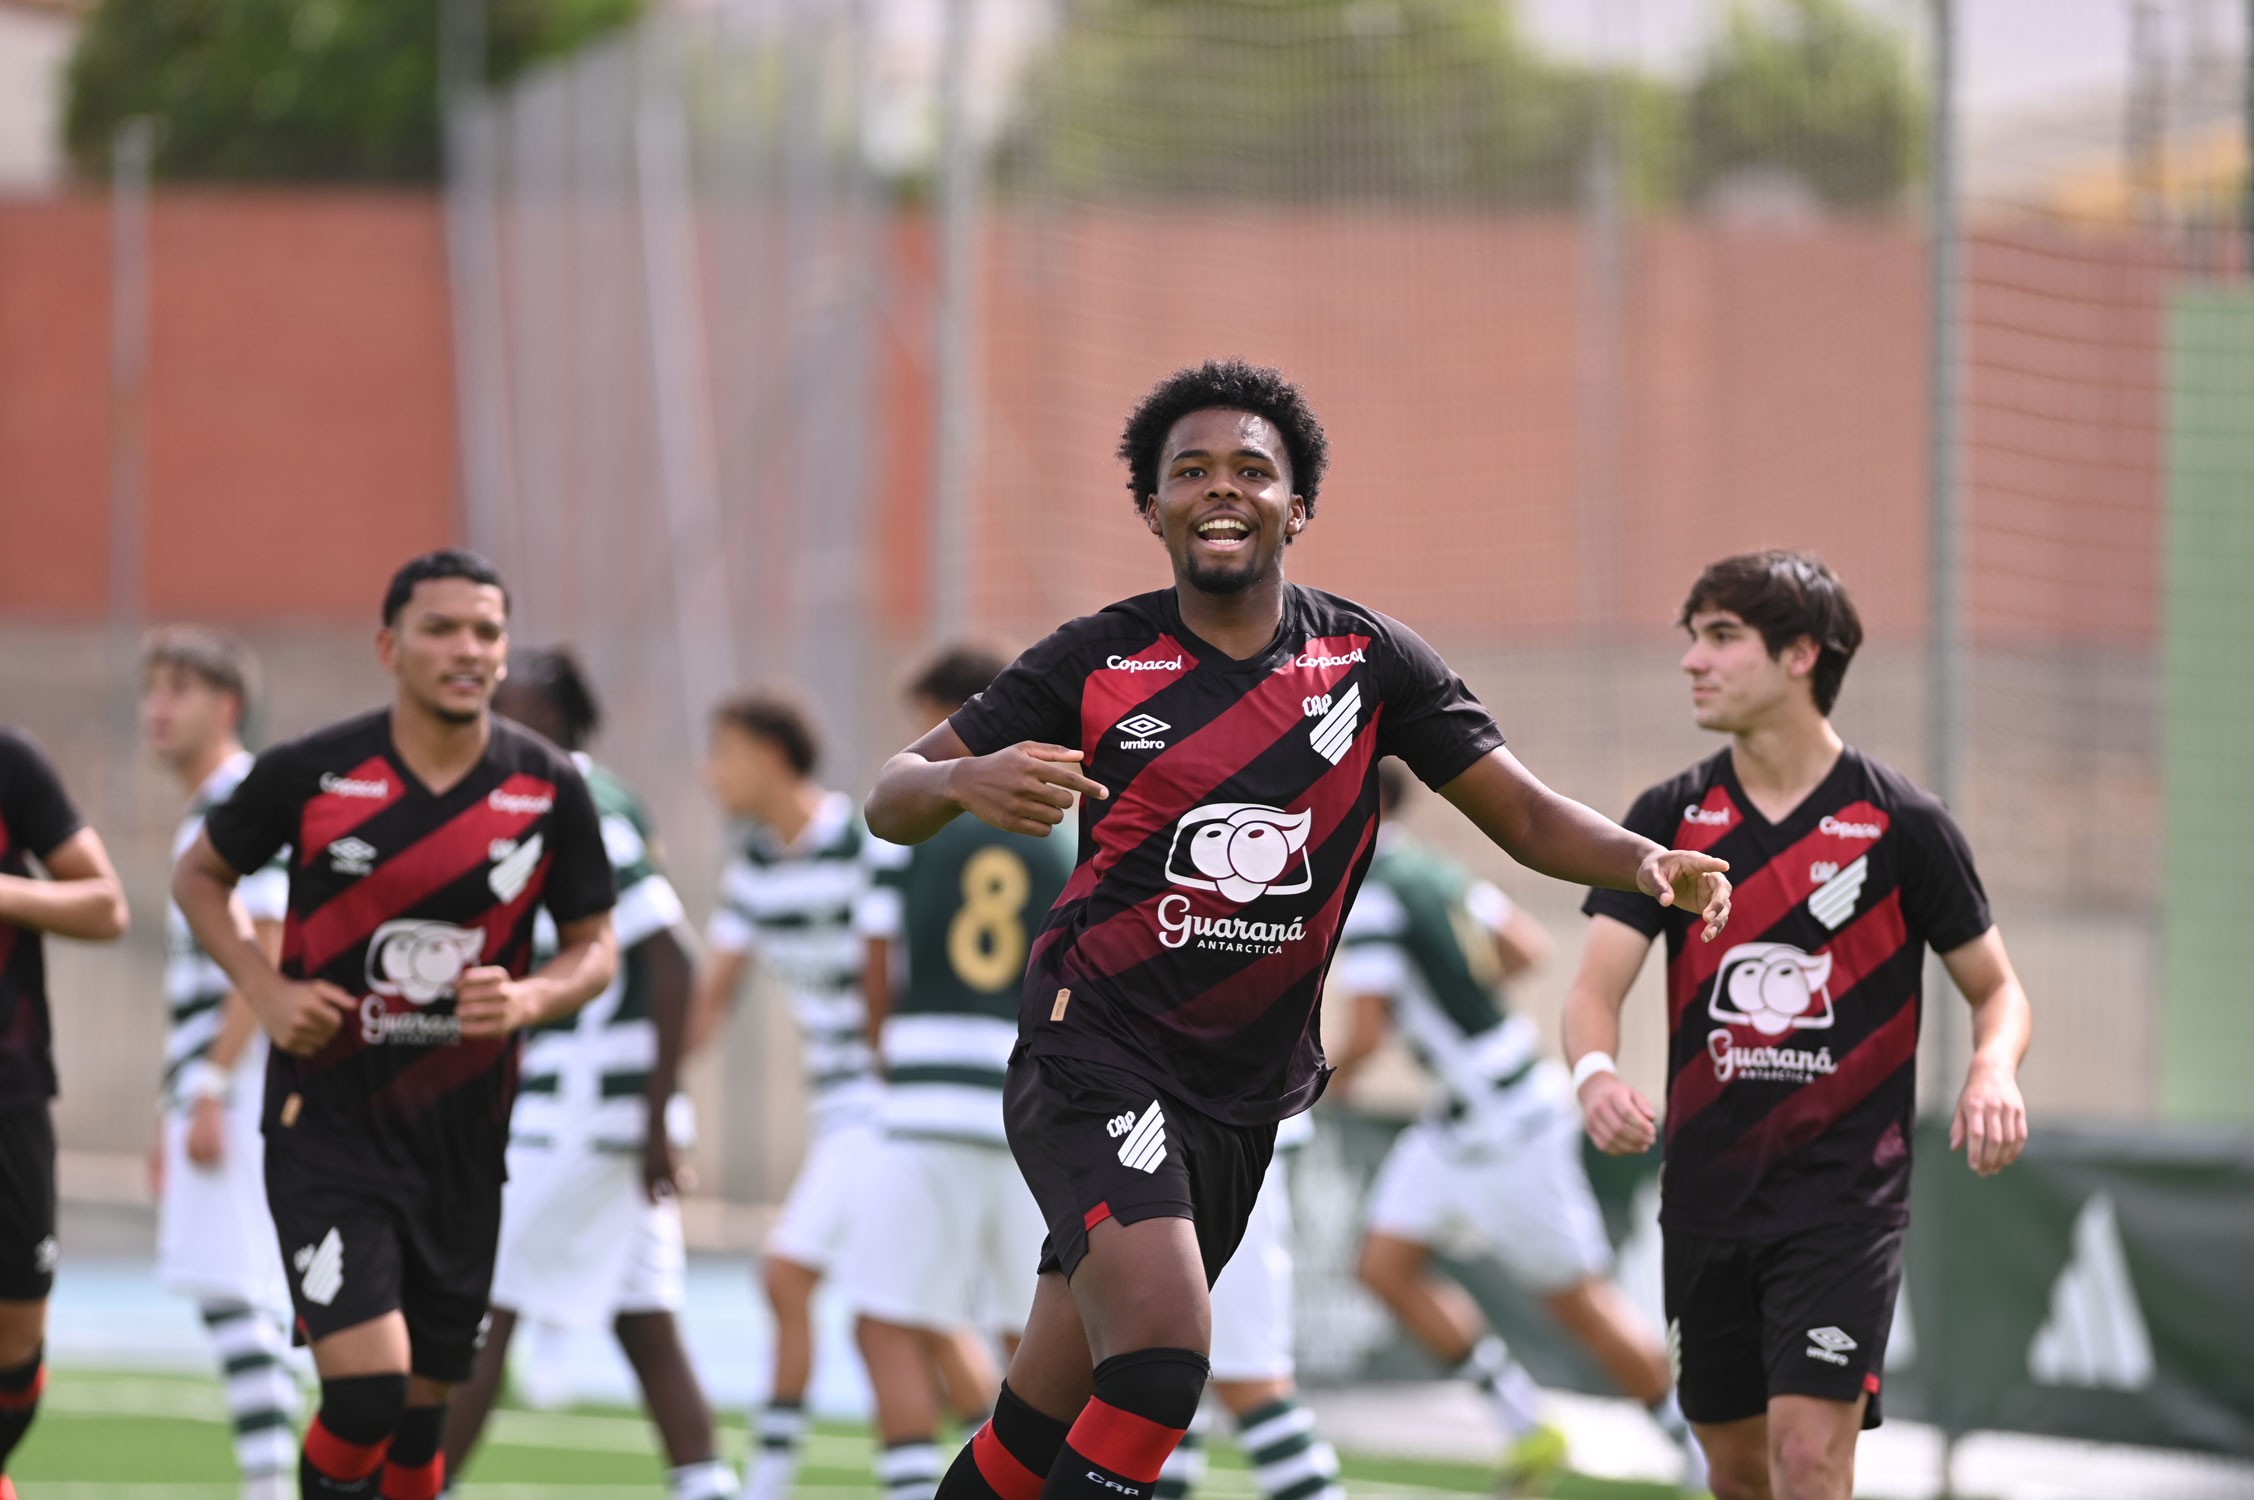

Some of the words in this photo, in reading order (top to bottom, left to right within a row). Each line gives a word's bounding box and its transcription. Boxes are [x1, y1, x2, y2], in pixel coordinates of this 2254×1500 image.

[1106, 654, 1182, 674] Copacol
[1295, 647, 1367, 670] Copacol
[1120, 738, 1166, 750] umbro
[948, 845, 1031, 993] 8
[1157, 894, 1307, 949] Guaraná
[1197, 939, 1283, 955] ANTARCTICA
[1707, 1028, 1838, 1082] Guaraná
[1085, 1471, 1139, 1496] CAP
